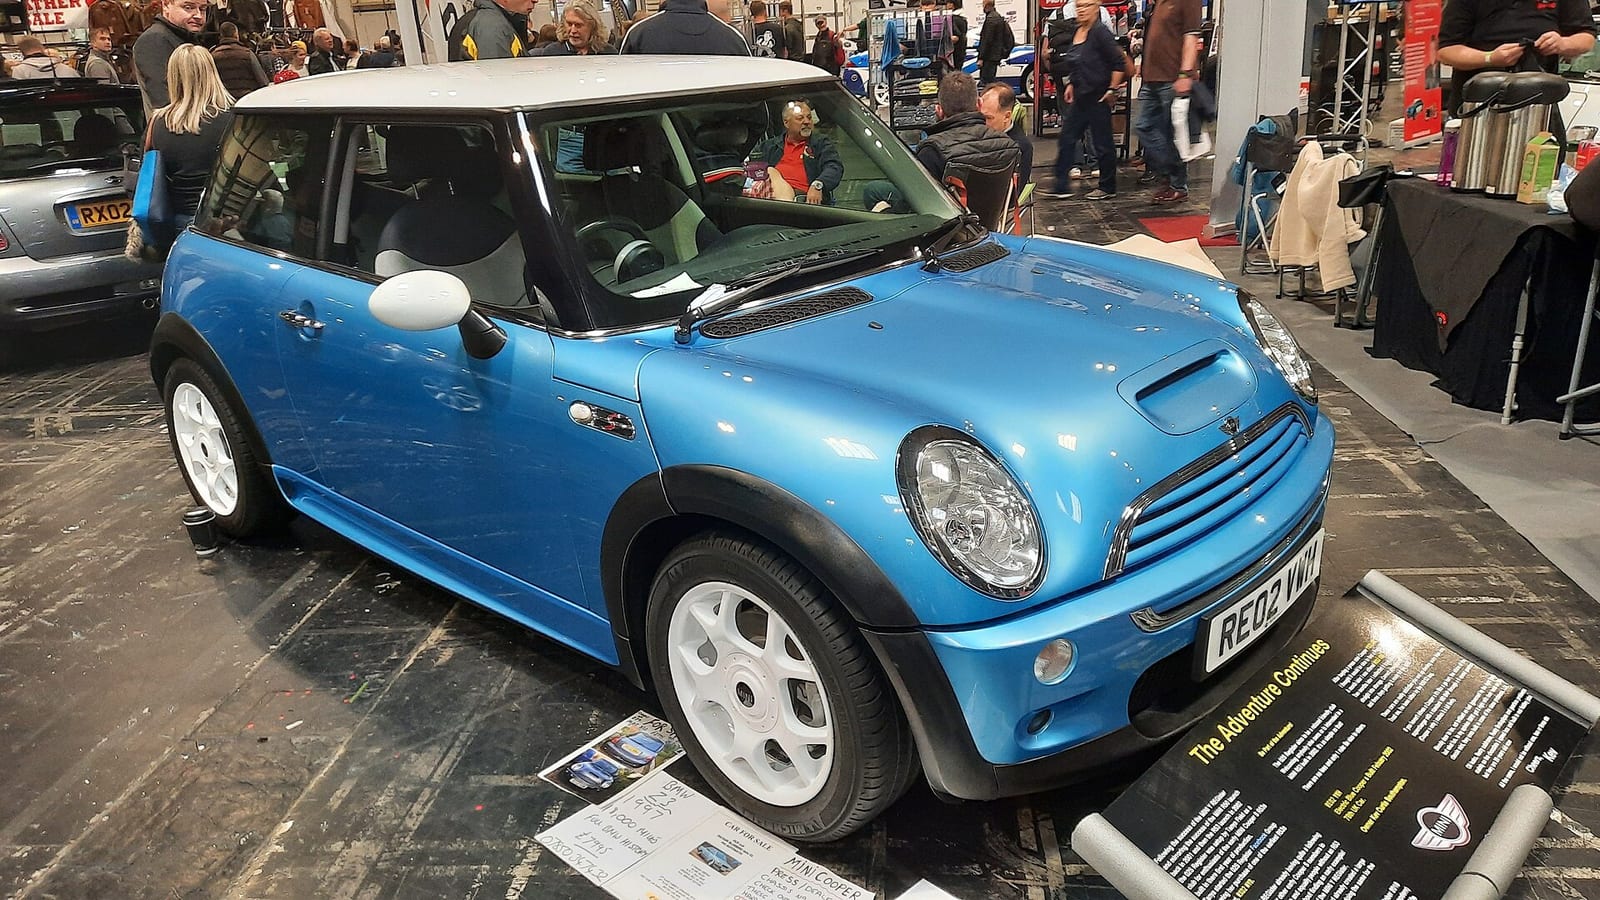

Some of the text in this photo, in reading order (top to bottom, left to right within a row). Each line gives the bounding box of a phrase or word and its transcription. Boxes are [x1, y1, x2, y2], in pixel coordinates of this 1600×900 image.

[81, 203, 131, 224] RX02
[1219, 578, 1281, 657] RE02
[1188, 737, 1225, 765] The
[1217, 682, 1282, 743] Adventure
[1273, 638, 1330, 688] Continues
[1542, 746, 1559, 763] Kev
[649, 791, 677, 807] Z3
[662, 780, 695, 800] BMW
[624, 795, 664, 820] 1997
[723, 821, 741, 832] CAR
[738, 829, 755, 840] FOR
[752, 837, 774, 851] SALE
[1431, 815, 1452, 836] MINI
[815, 872, 862, 900] COOPER
